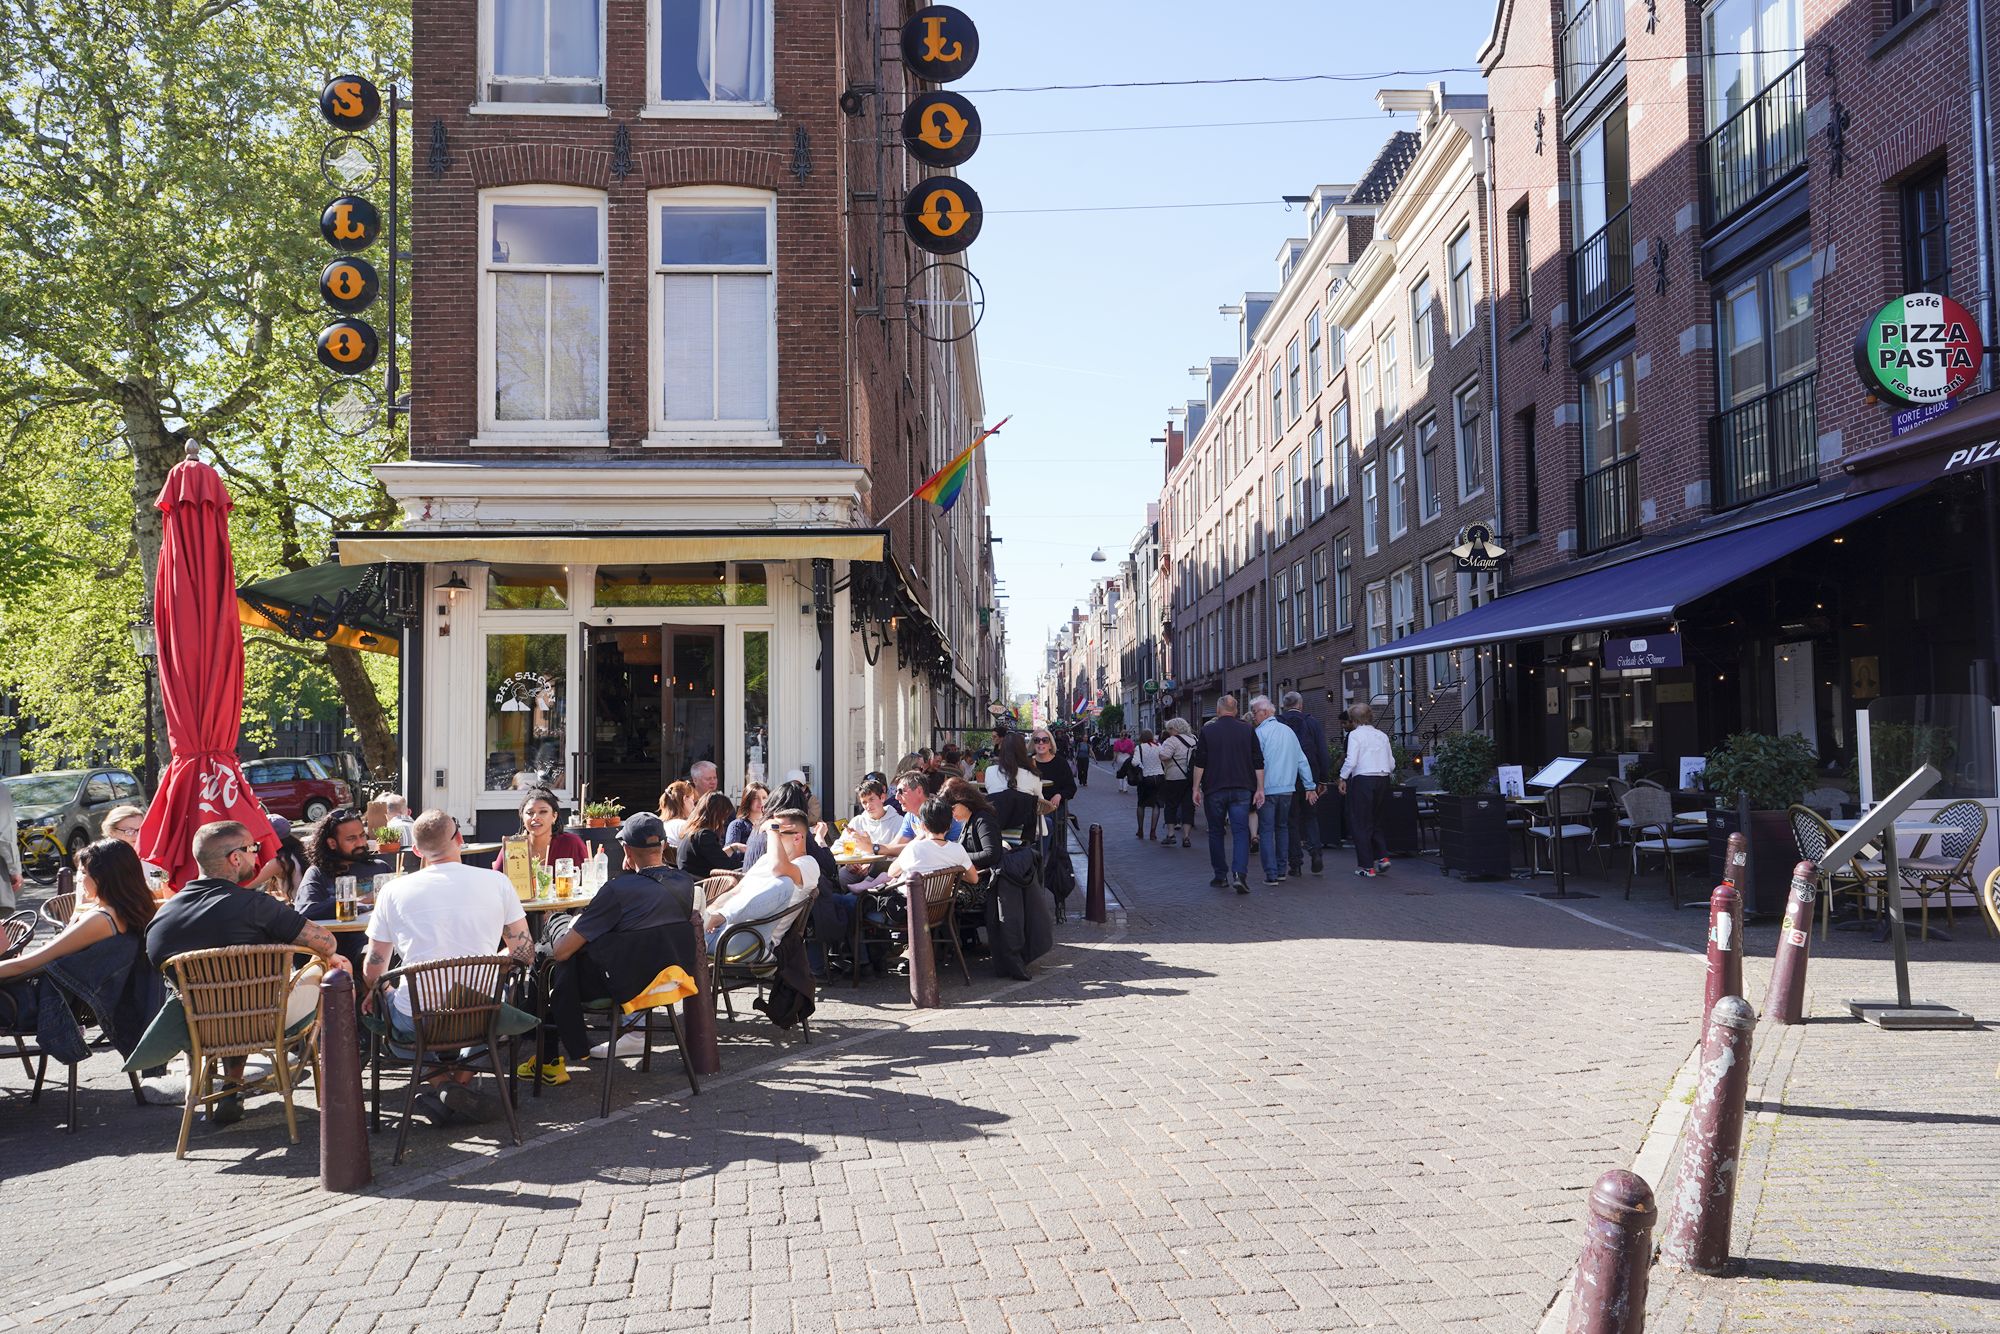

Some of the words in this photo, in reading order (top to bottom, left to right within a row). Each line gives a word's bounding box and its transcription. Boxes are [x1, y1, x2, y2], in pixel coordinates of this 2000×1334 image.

[1906, 296, 1940, 309] café
[1880, 323, 1970, 344] PIZZA
[1879, 348, 1972, 369] PASTA
[1890, 373, 1965, 398] restaurant
[1897, 408, 1921, 426] KORTE
[1459, 555, 1499, 571] Mayur
[495, 677, 514, 703] BAR
